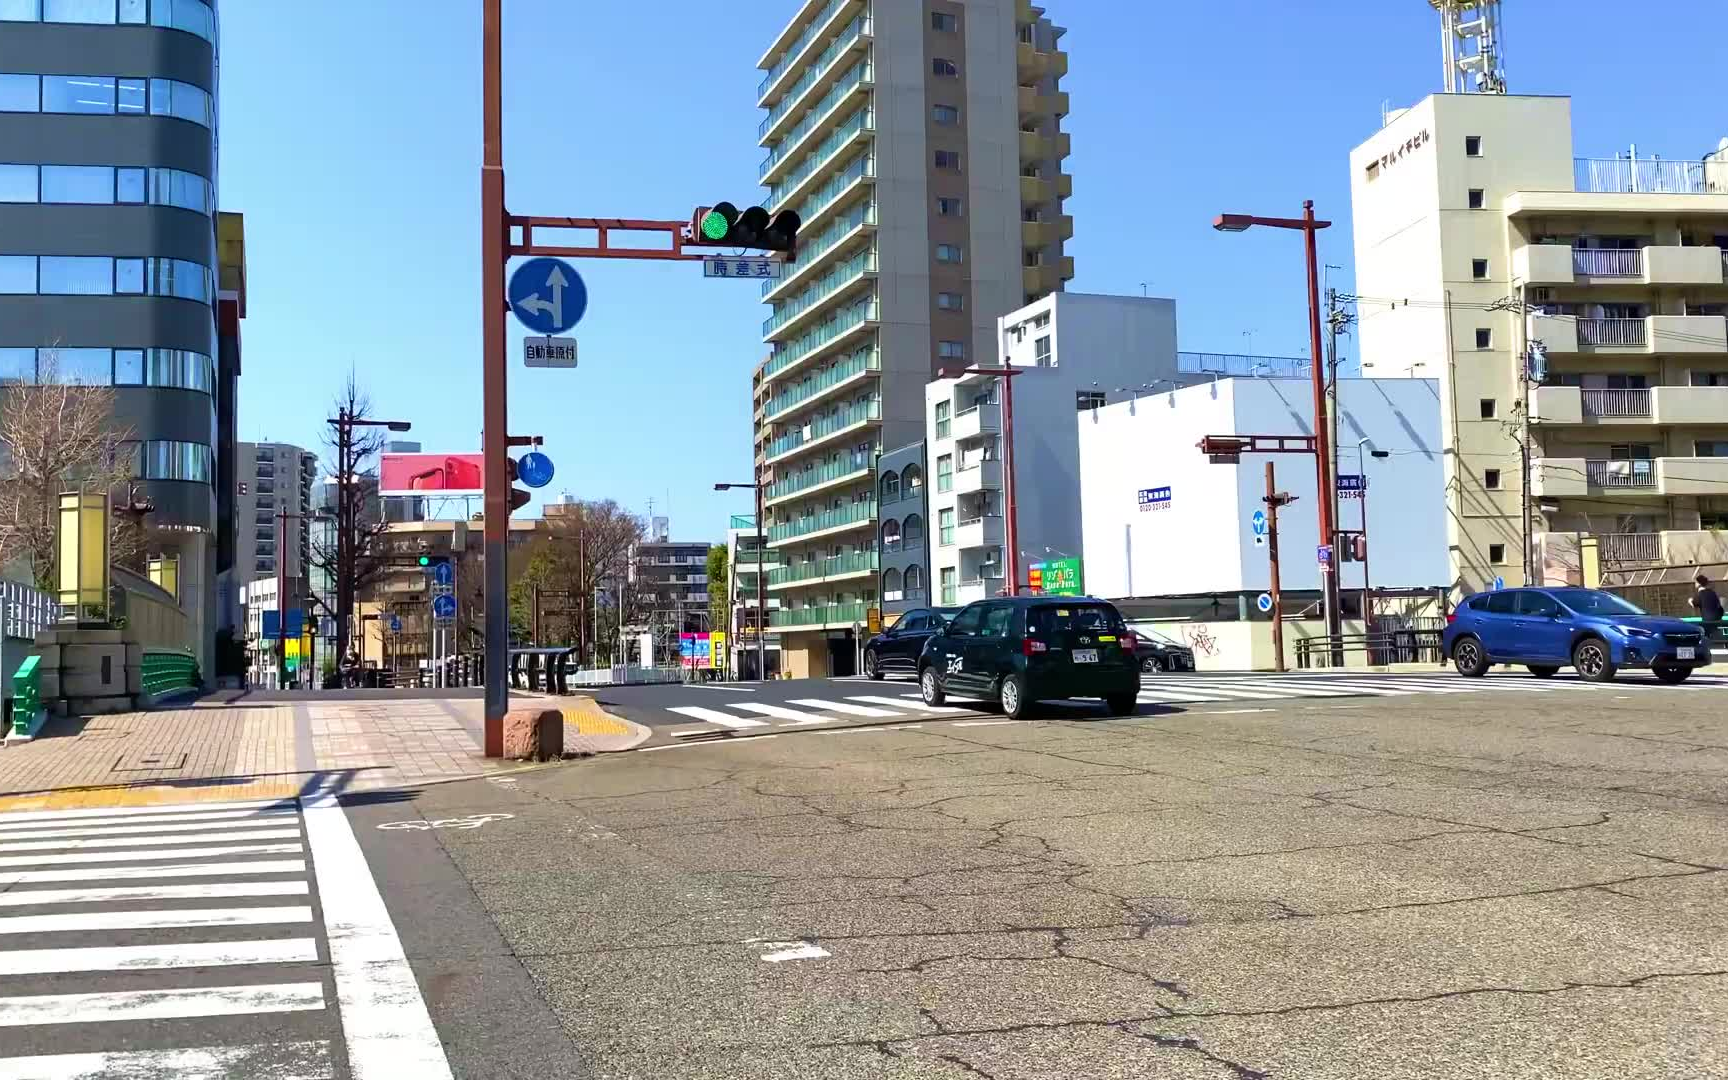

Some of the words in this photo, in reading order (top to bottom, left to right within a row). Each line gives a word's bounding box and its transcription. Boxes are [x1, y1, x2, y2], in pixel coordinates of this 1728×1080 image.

[1381, 128, 1430, 169] マルイチビル
[714, 261, 771, 276] 時差式
[526, 345, 574, 360] 自動車原付
